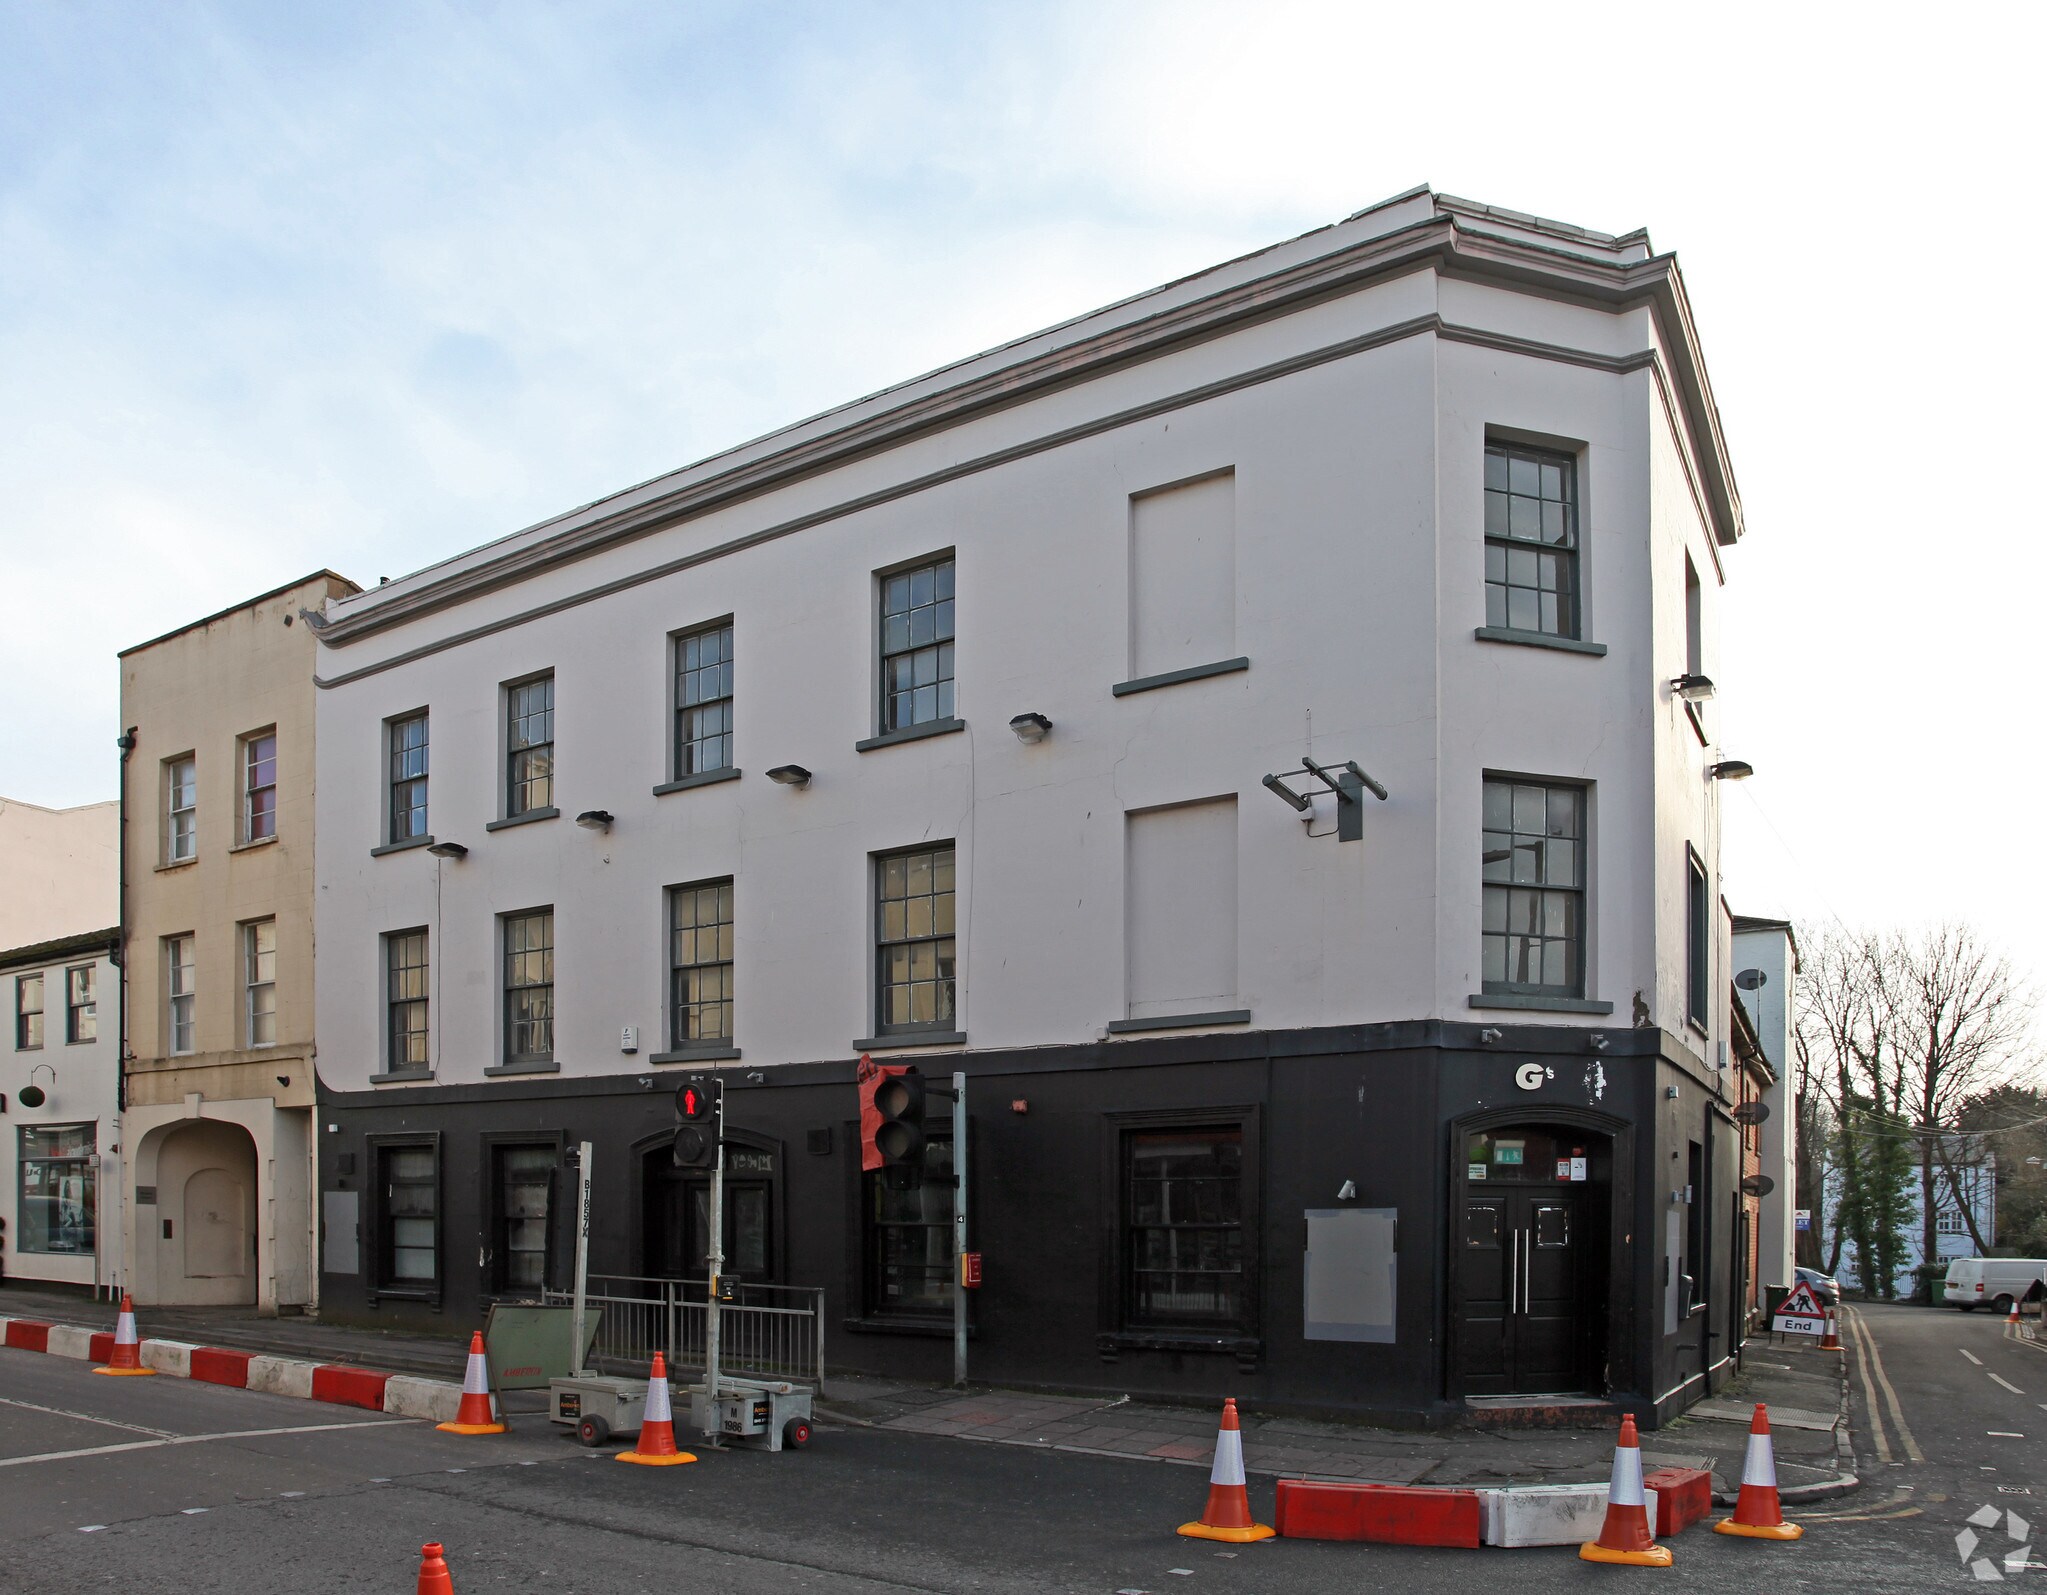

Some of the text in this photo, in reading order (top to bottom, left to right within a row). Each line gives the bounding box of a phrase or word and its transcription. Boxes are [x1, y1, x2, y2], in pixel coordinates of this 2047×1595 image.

[1515, 1063, 1554, 1090] G's
[1785, 1319, 1812, 1331] End
[731, 1407, 738, 1418] M
[724, 1420, 742, 1432] 1986
